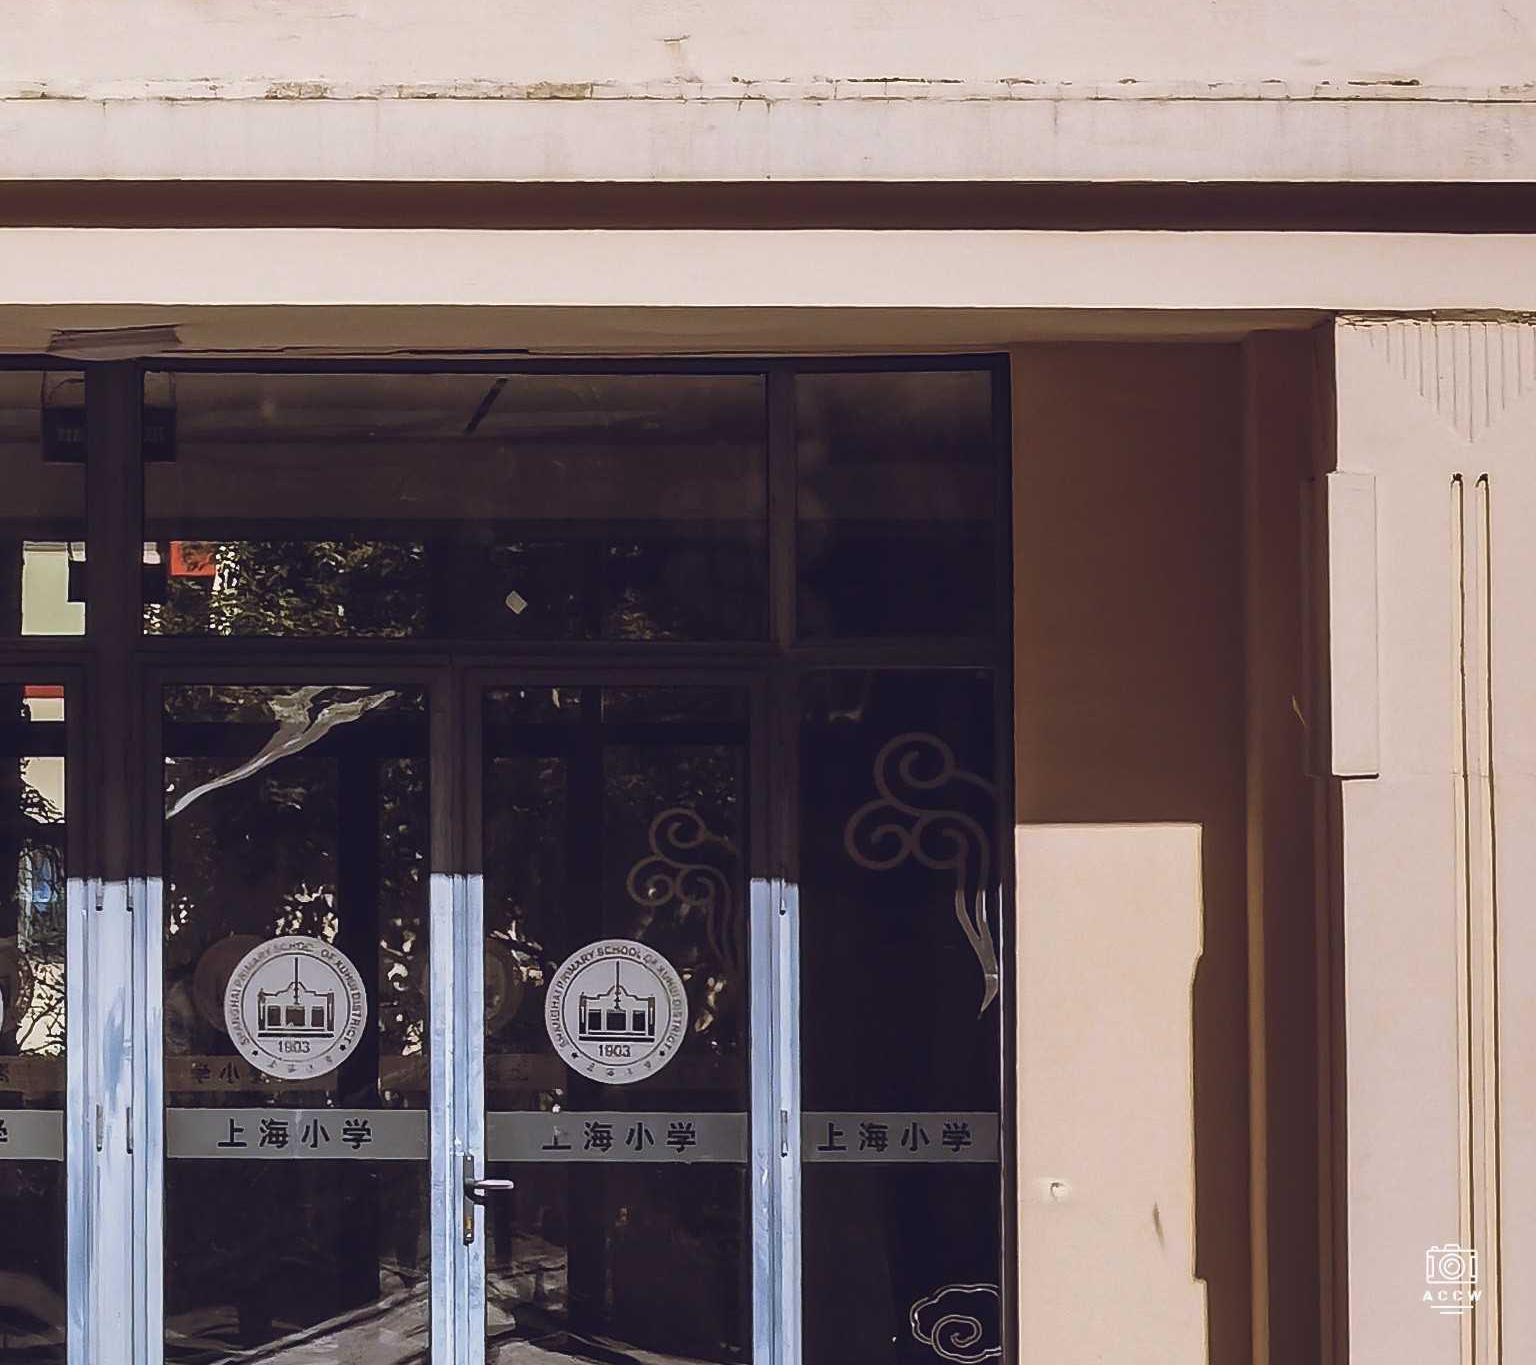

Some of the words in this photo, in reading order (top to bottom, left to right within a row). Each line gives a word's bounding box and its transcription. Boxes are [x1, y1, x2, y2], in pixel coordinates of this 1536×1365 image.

[278, 1040, 311, 1053] 1903
[599, 1045, 631, 1058] 1903
[217, 1117, 372, 1150] 上海小学
[542, 1121, 697, 1153] 上海小学
[817, 1122, 972, 1152] 上海小学
